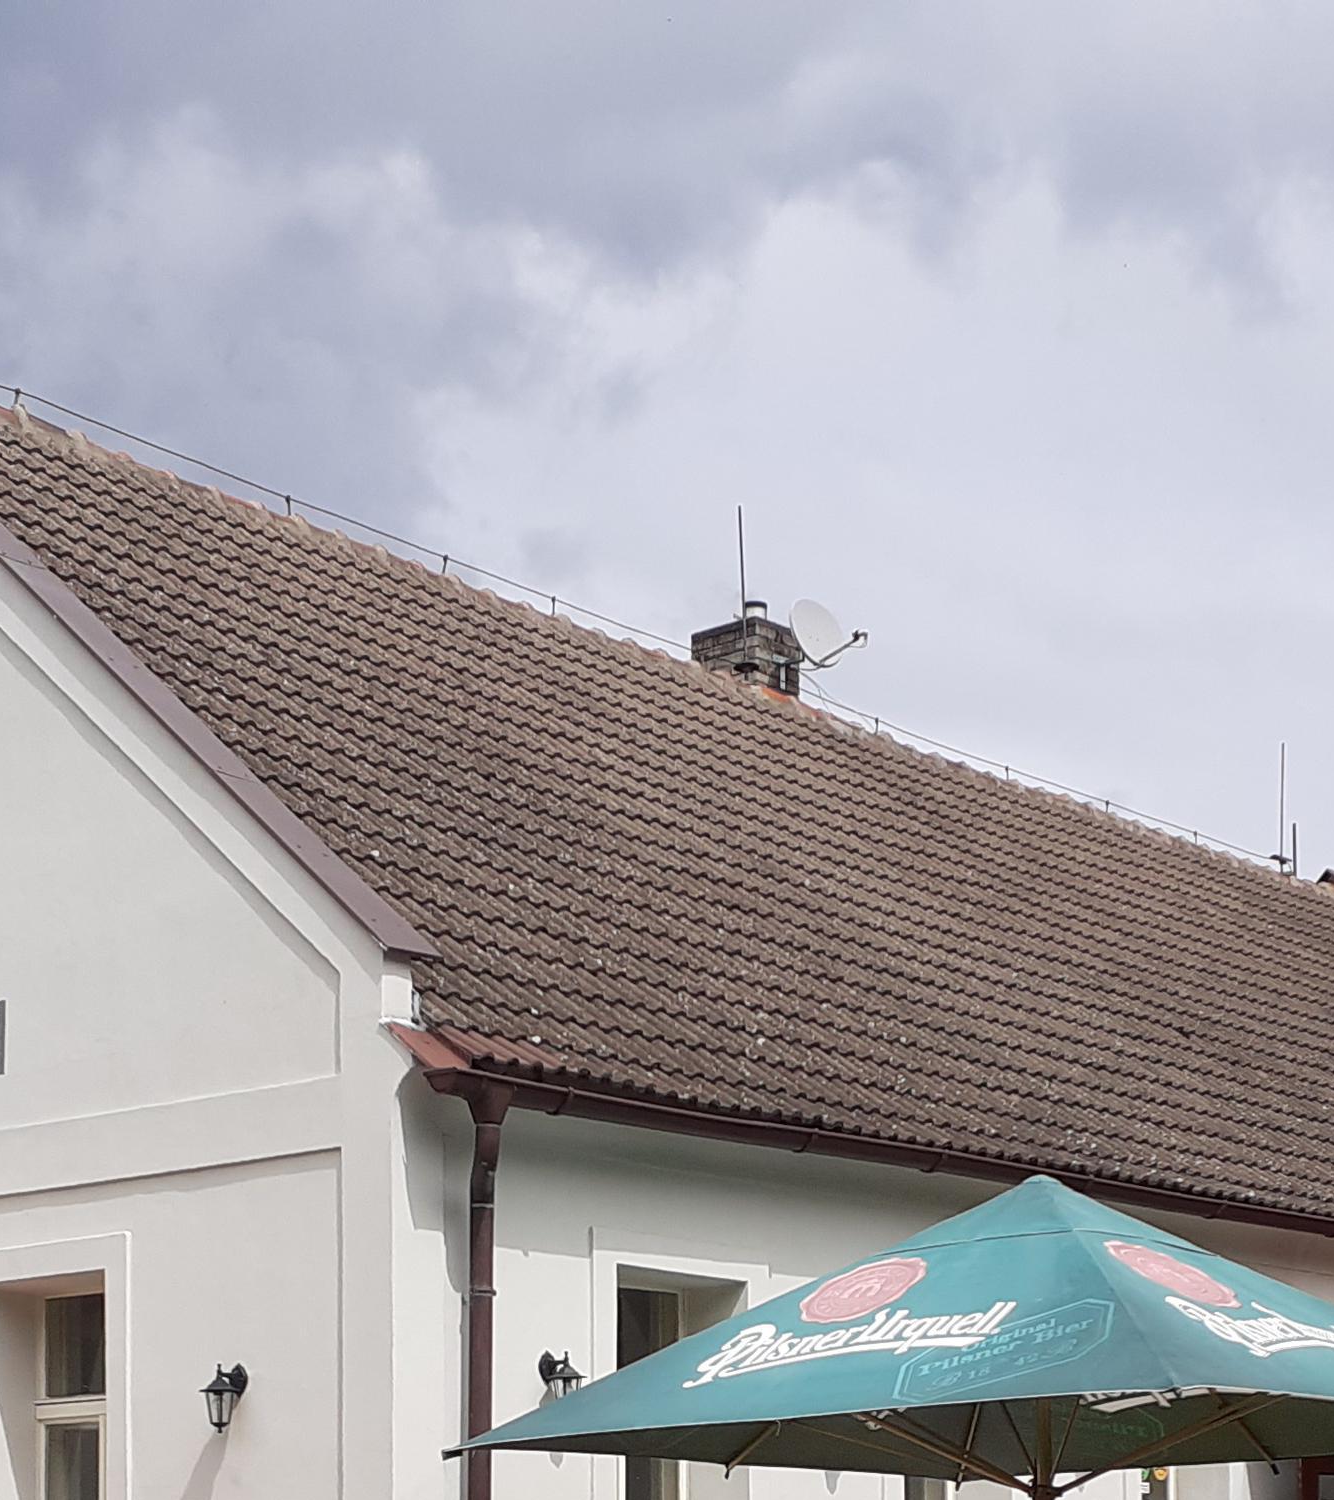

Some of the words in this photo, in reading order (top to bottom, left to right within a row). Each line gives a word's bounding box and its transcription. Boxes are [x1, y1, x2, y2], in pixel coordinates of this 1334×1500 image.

[682, 1323, 869, 1389] Pilsner
[918, 1341, 1022, 1377] Pilsner
[1033, 1319, 1094, 1344] Bier
[961, 1318, 1057, 1352] Original
